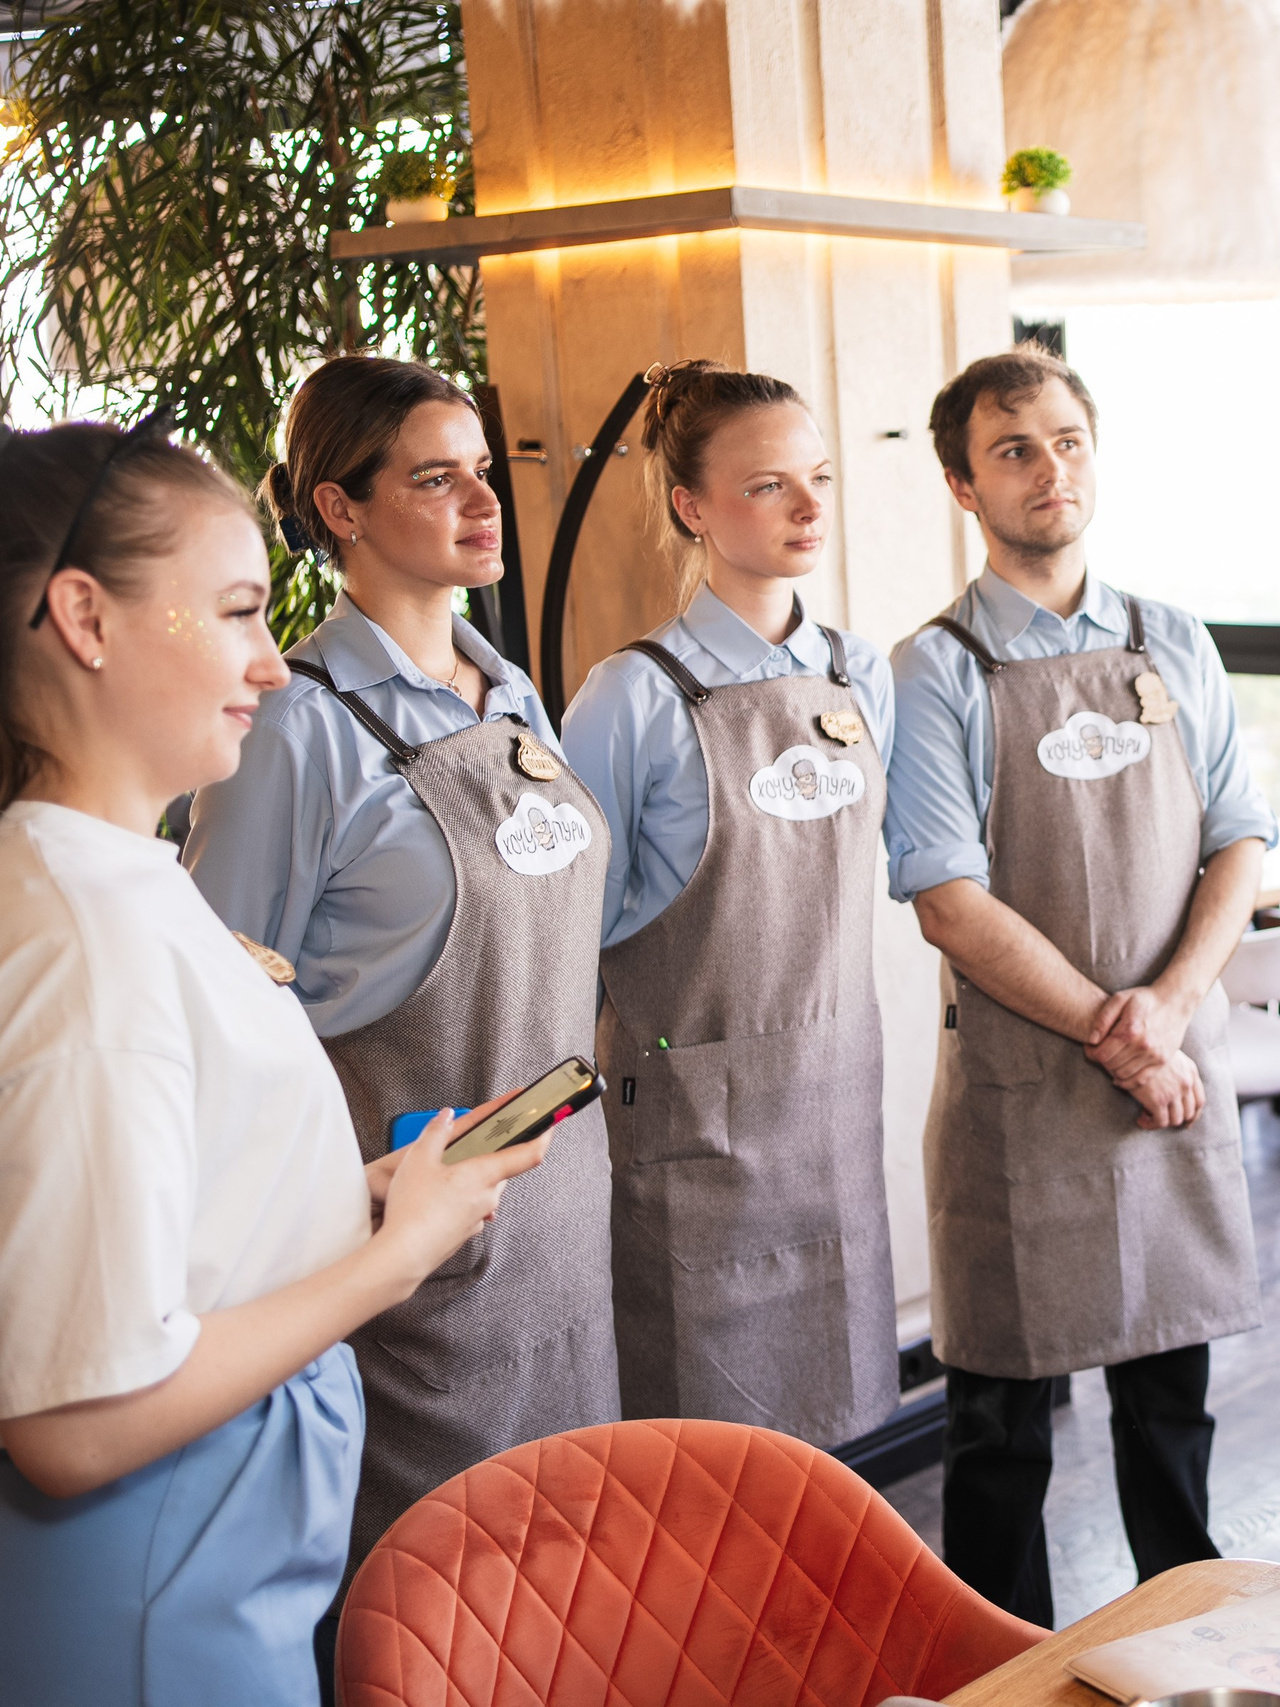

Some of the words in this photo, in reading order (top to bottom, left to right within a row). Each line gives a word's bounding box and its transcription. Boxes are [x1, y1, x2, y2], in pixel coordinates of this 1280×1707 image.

[757, 776, 797, 801] ХОЧУ
[818, 774, 856, 796] ПУРИ
[502, 830, 537, 855] ХОЧУ
[552, 821, 585, 844] ПУРИ
